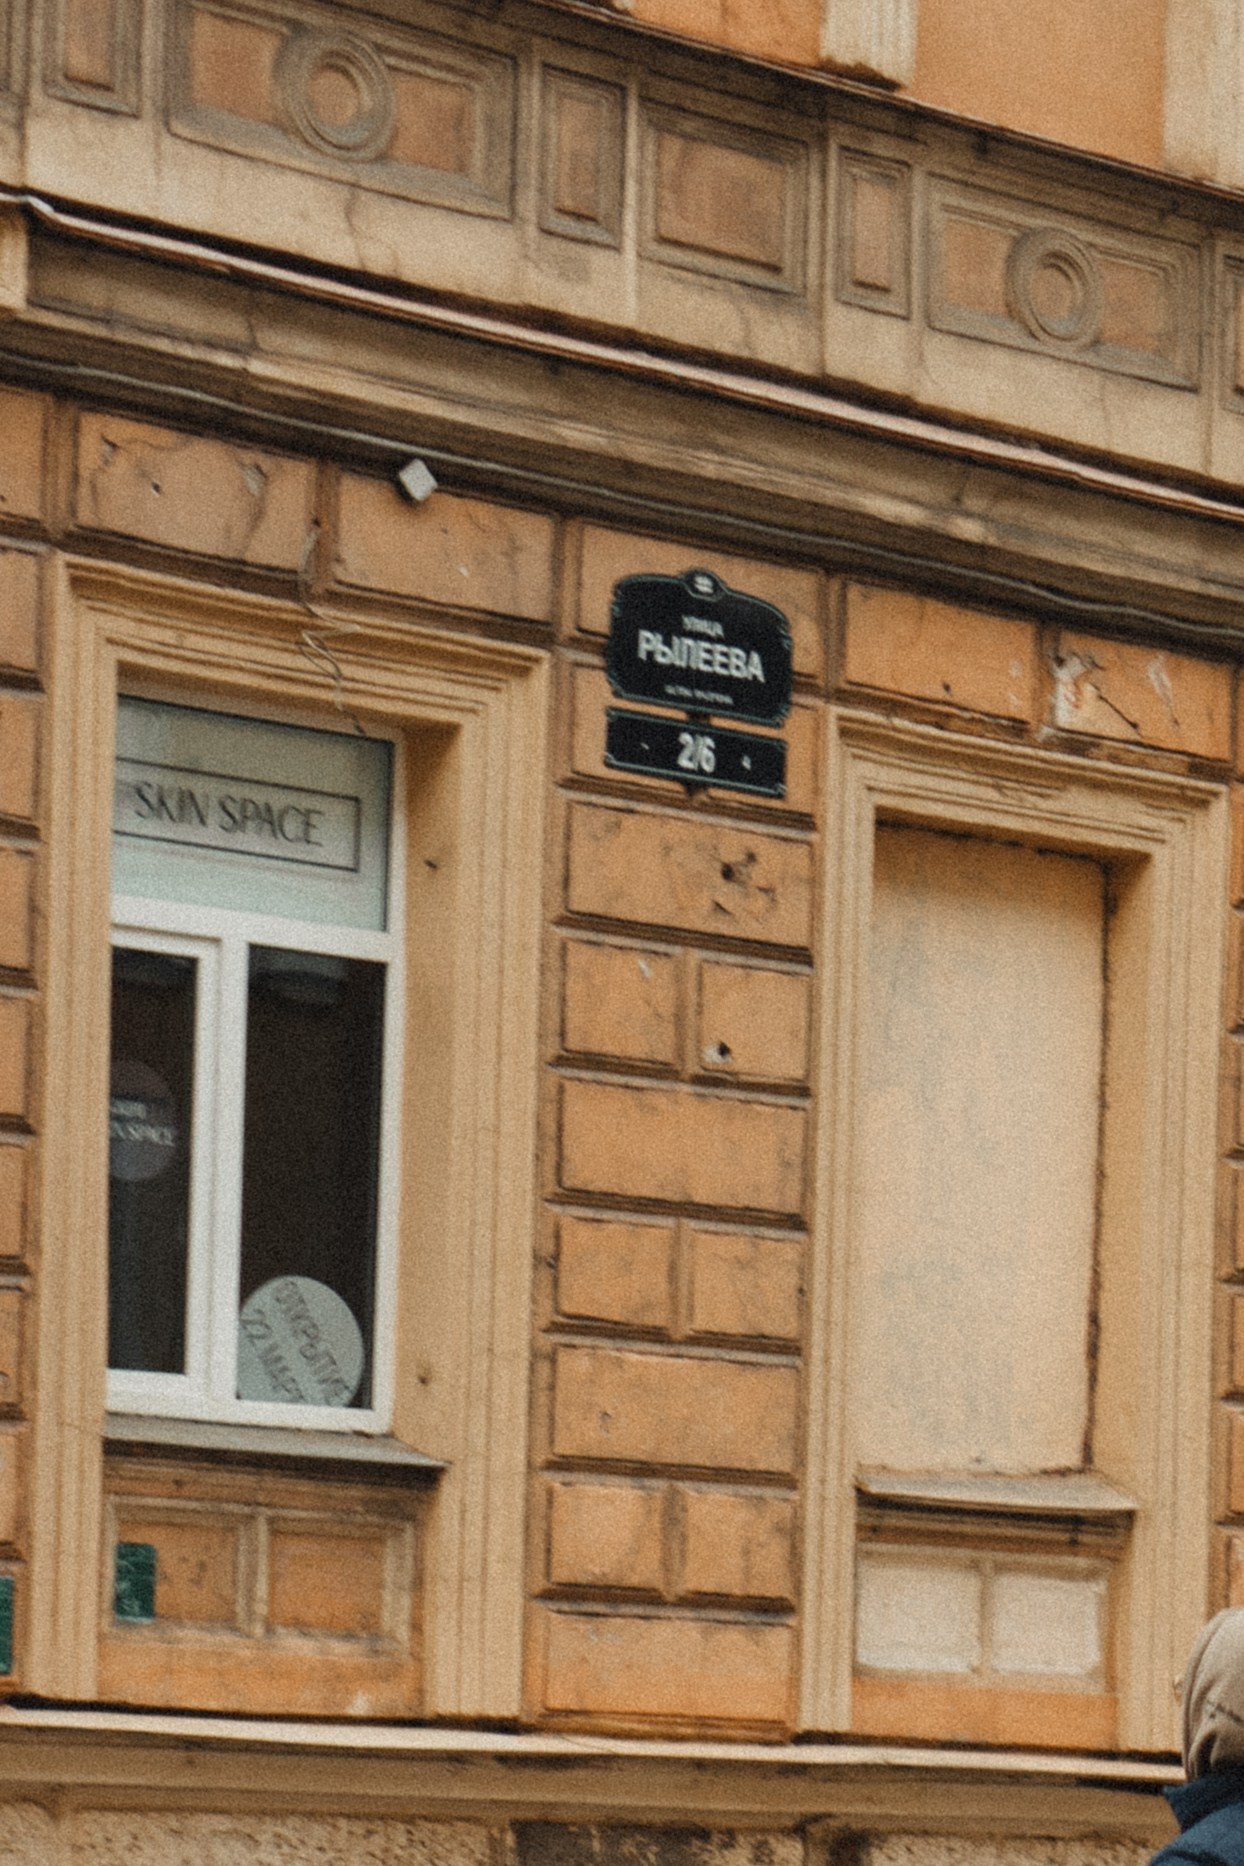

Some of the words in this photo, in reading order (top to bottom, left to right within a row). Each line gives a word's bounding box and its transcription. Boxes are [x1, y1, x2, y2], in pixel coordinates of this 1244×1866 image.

[637, 629, 765, 683] РЫЛЕЕВА
[134, 781, 208, 826] SKIN
[218, 795, 325, 847] SPACE
